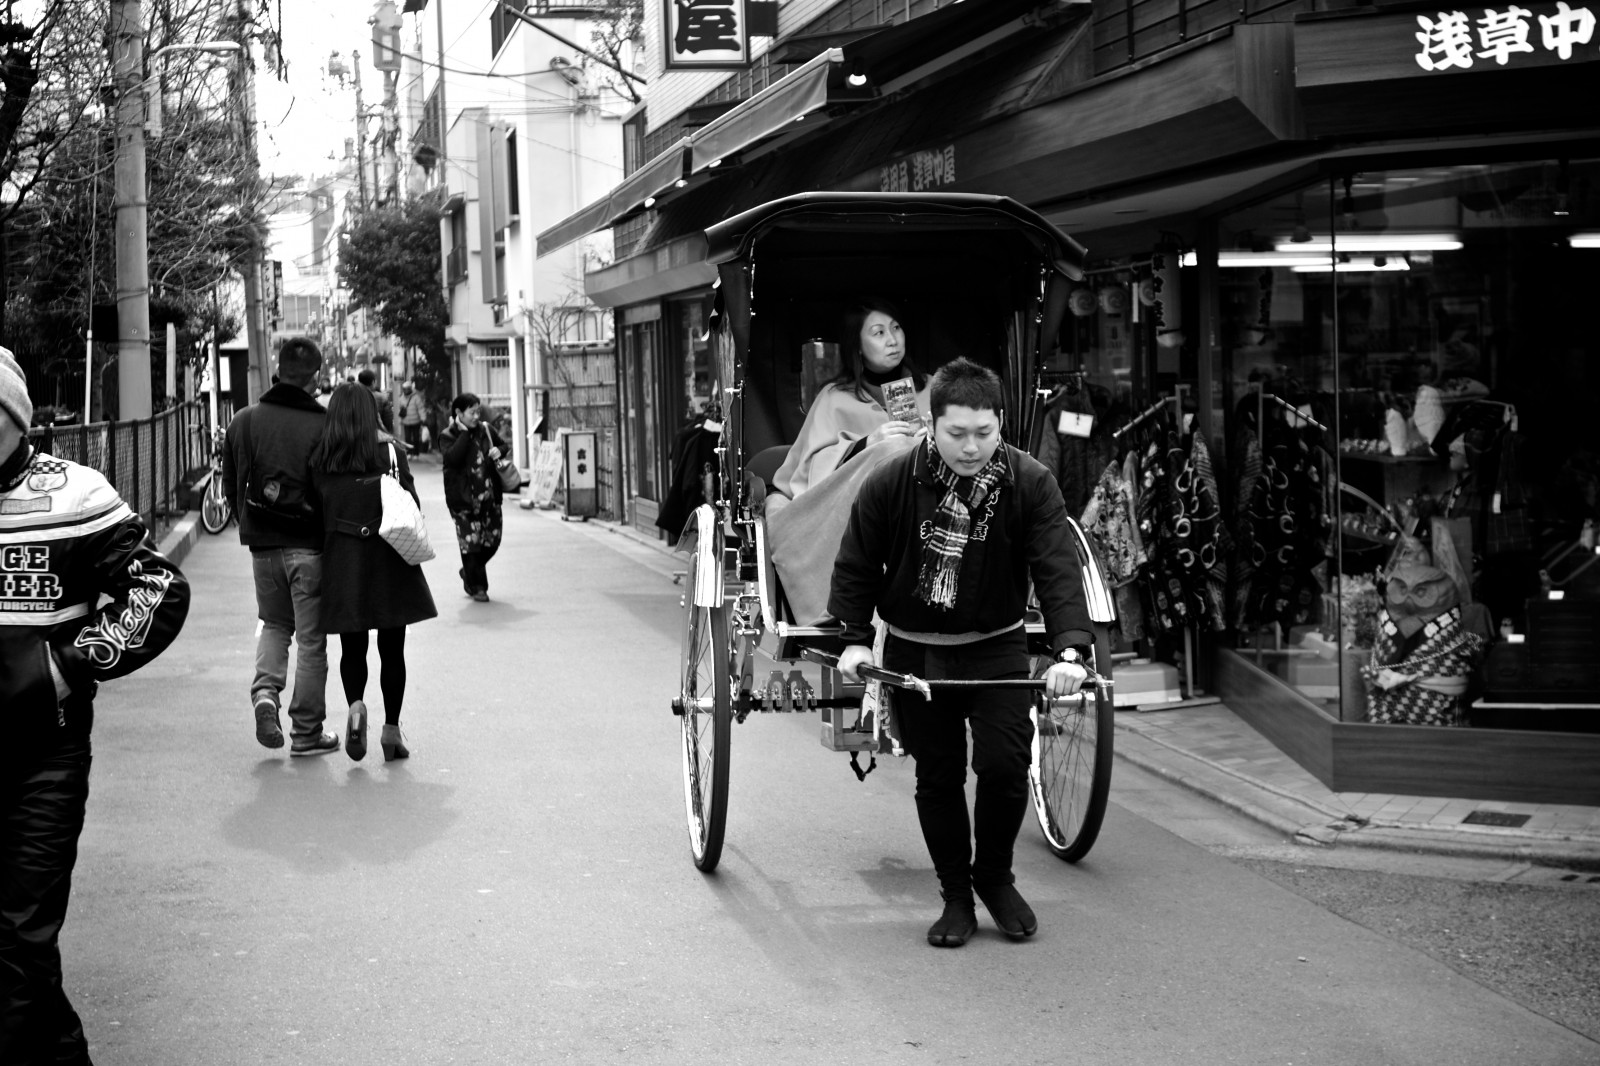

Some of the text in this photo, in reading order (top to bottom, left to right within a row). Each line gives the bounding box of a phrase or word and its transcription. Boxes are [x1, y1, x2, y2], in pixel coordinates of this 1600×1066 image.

[1415, 1, 1597, 72] 浅草中
[913, 144, 955, 191] 浅草中屋
[0, 545, 50, 572] GE
